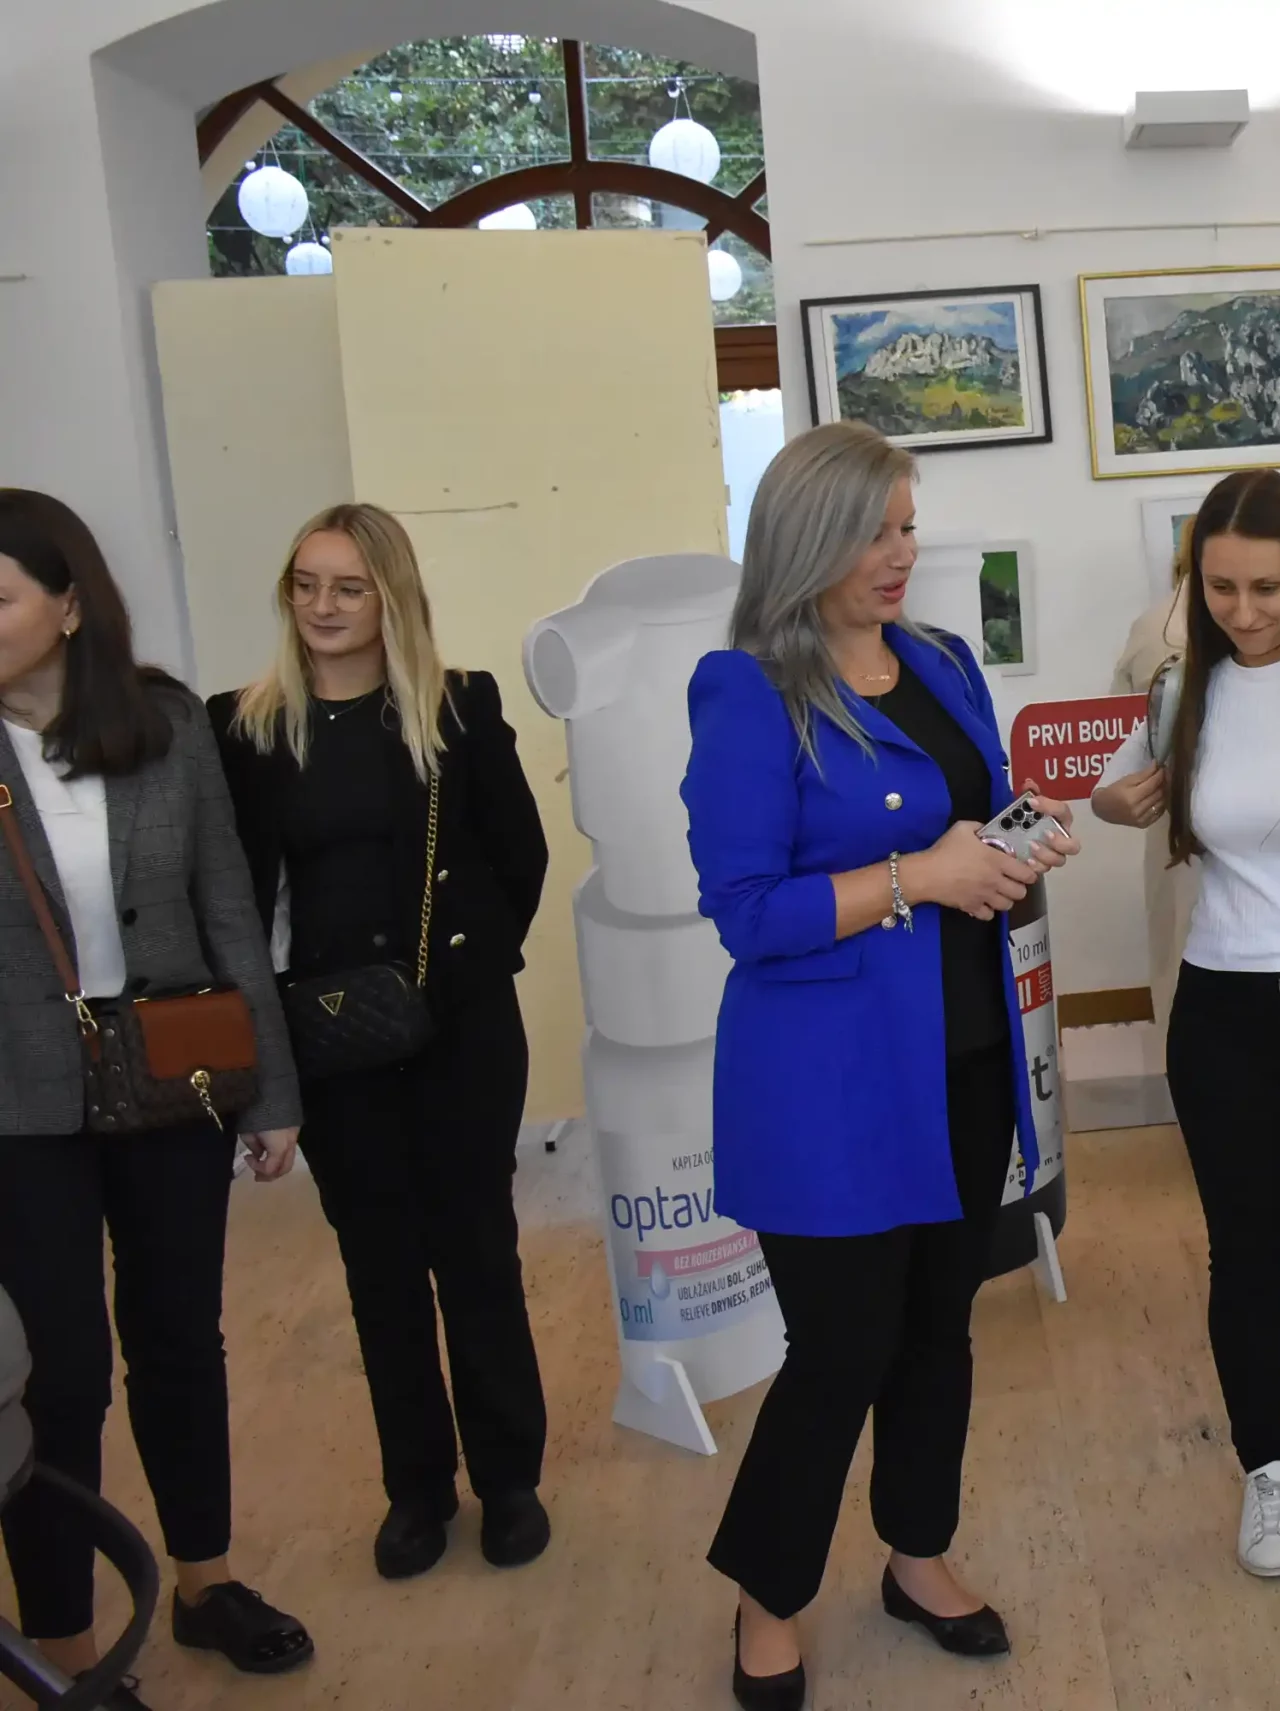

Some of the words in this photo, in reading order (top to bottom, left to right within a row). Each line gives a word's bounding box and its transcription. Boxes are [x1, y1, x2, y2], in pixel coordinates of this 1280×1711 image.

[1028, 722, 1072, 747] PRVI
[1079, 716, 1147, 743] BOULA
[1045, 758, 1058, 780] U
[1017, 944, 1030, 963] 10
[1033, 933, 1047, 956] ml
[1038, 967, 1052, 1001] SHOT
[672, 1155, 692, 1171] KAPI
[693, 1153, 704, 1168] ZA
[611, 1186, 720, 1242] optav
[674, 1256, 691, 1270] BEZ
[691, 1237, 748, 1268] KONZERVANSA
[678, 1277, 726, 1300] UBLAŽAVAJU
[727, 1270, 746, 1288] BOL,
[680, 1304, 711, 1321] RELIEVE
[711, 1290, 749, 1315] DRYNESS,
[750, 1276, 774, 1298] REDN
[634, 1298, 653, 1324] ml
